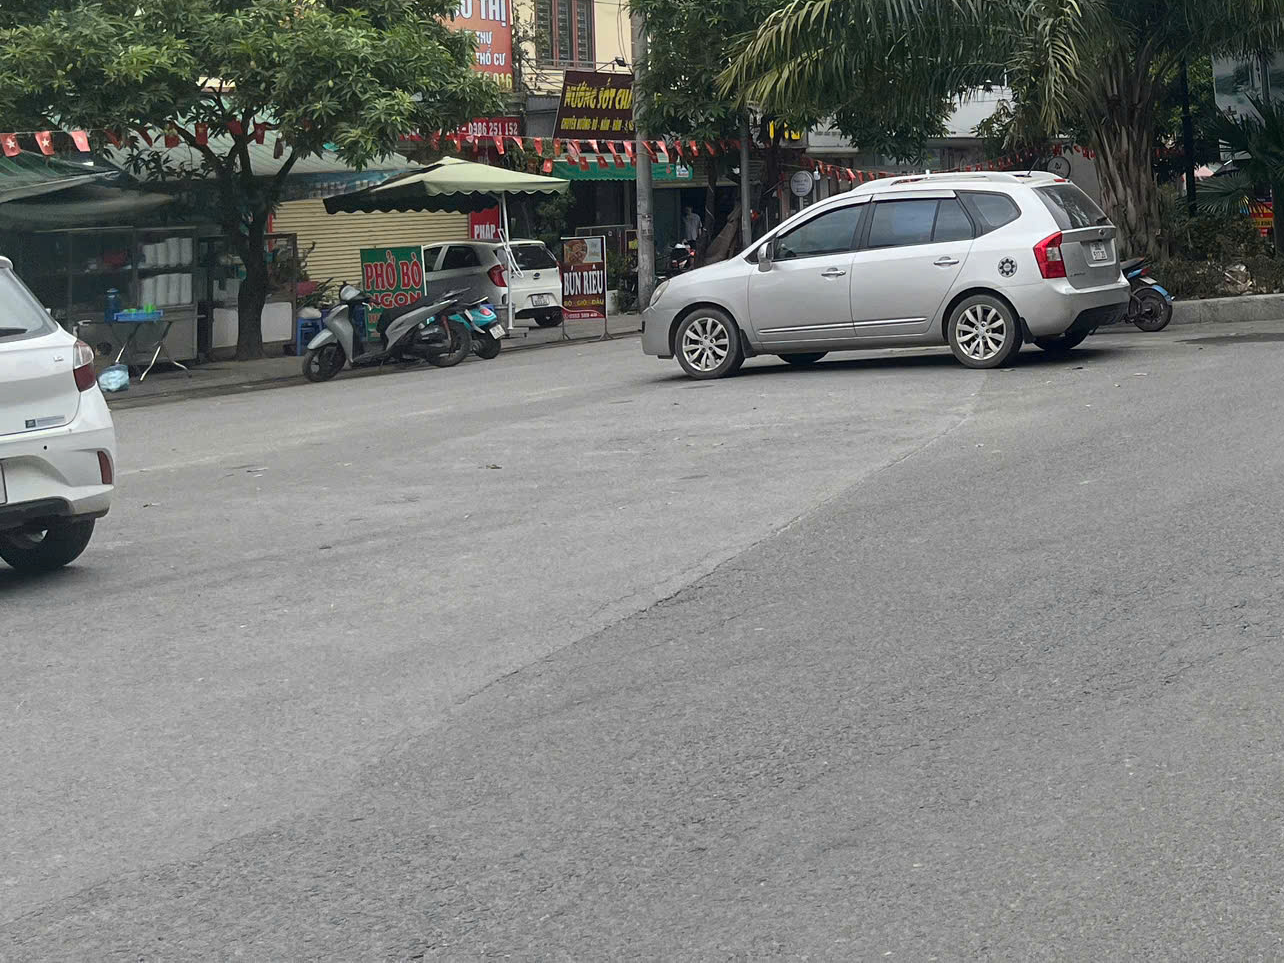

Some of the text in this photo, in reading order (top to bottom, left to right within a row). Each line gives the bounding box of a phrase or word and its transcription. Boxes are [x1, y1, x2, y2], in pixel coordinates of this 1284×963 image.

[468, 122, 487, 136] 0986
[489, 122, 502, 135] 251
[505, 122, 518, 135] 152
[363, 250, 422, 291] PHỞ BÒ
[563, 264, 603, 296] BÚN RIÊU
